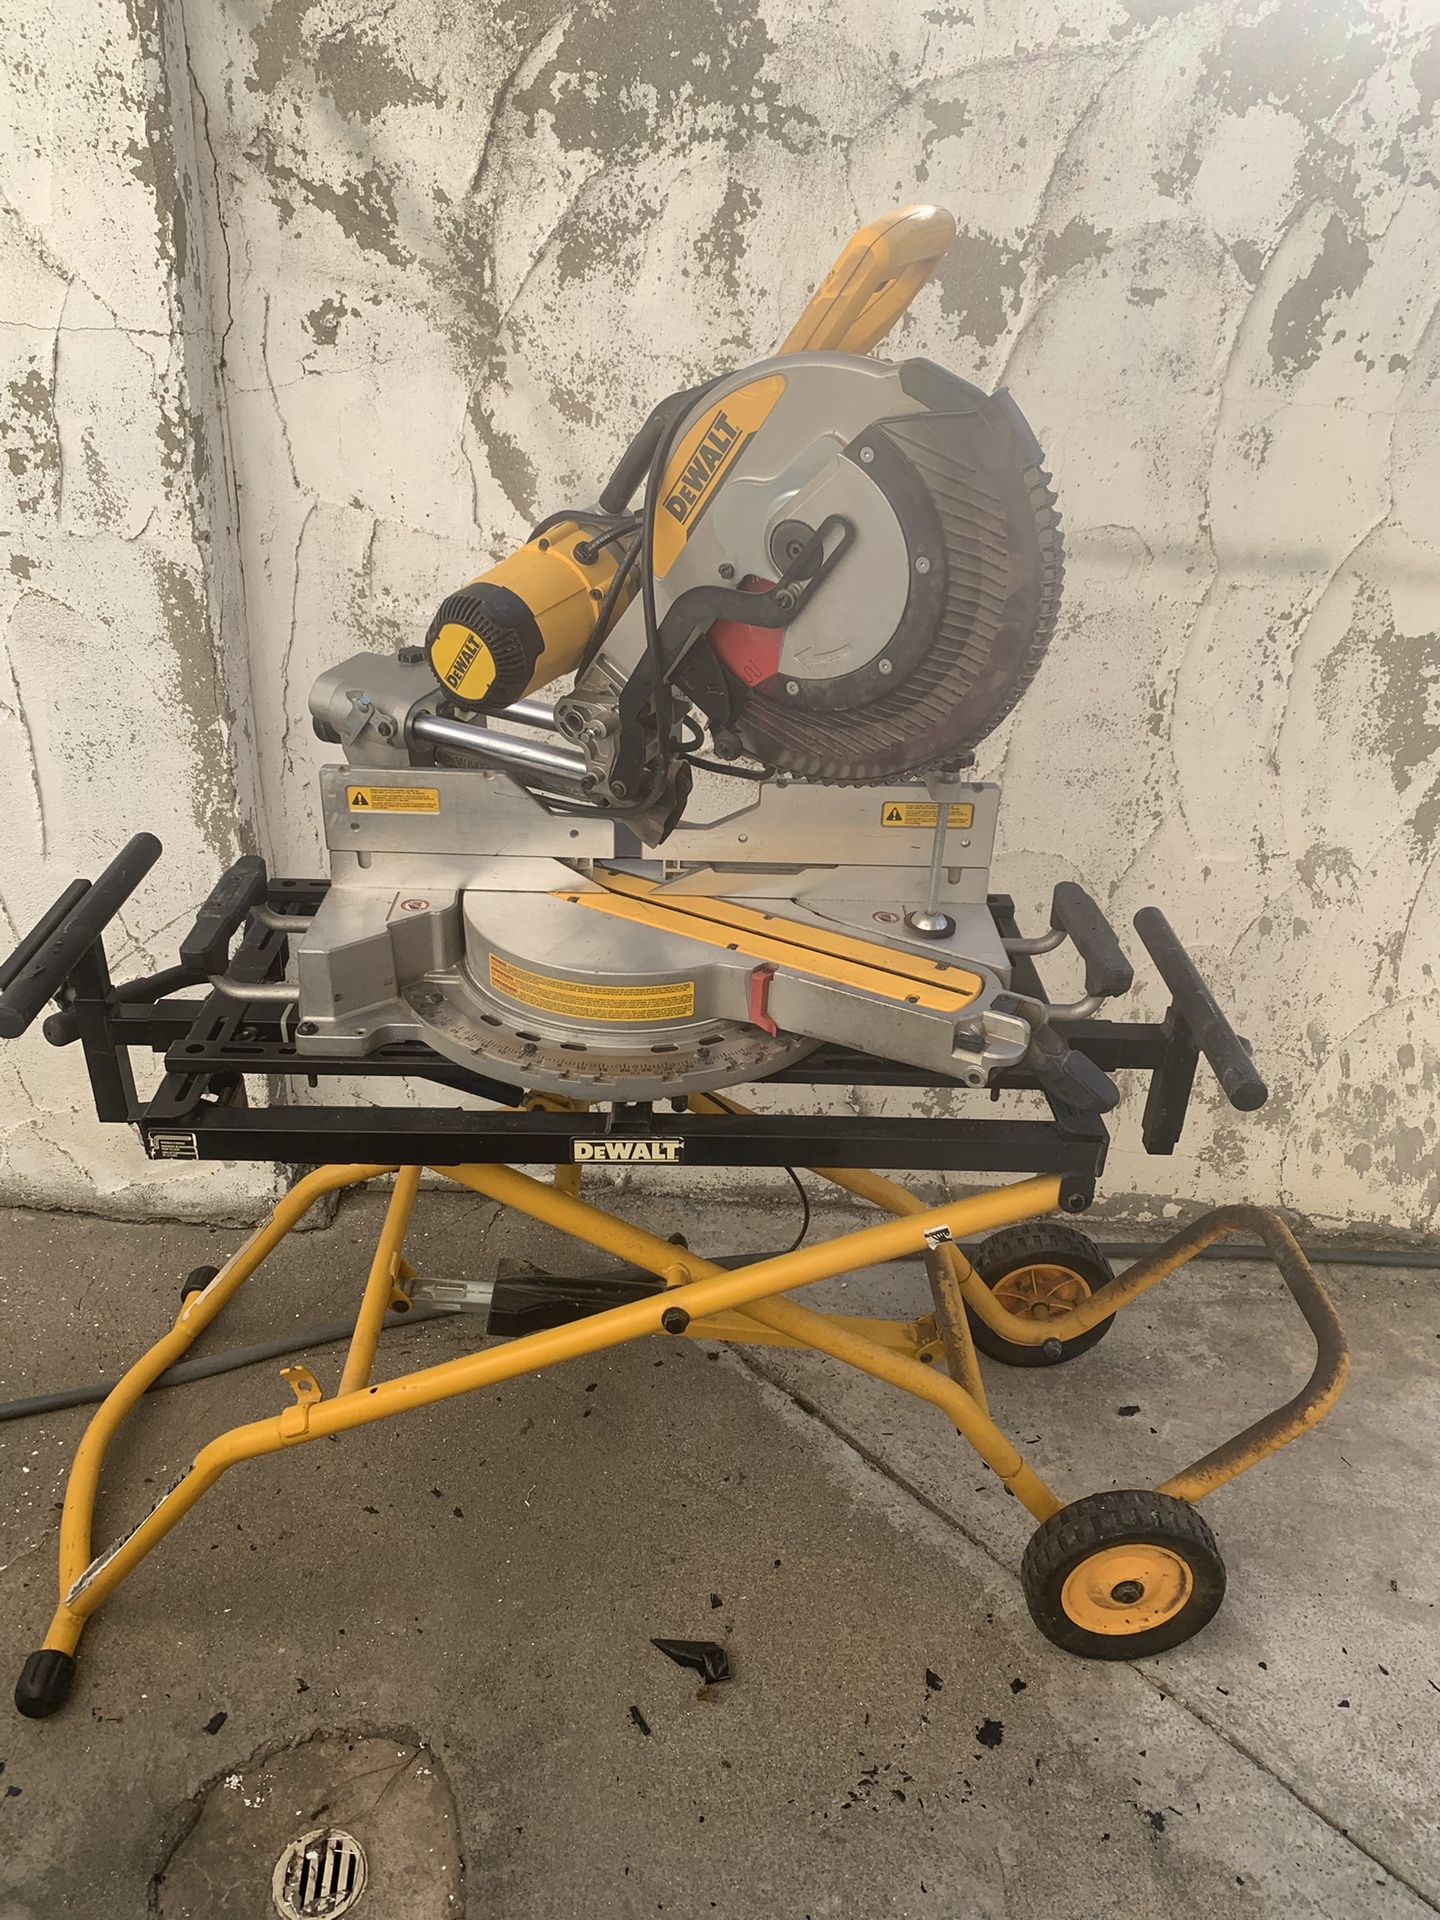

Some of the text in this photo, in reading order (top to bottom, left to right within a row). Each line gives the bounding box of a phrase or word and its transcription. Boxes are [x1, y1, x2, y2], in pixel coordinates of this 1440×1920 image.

[664, 411, 741, 523] DEWALT
[446, 635, 480, 688] DEWALT
[574, 1142, 679, 1160] DEWALT
